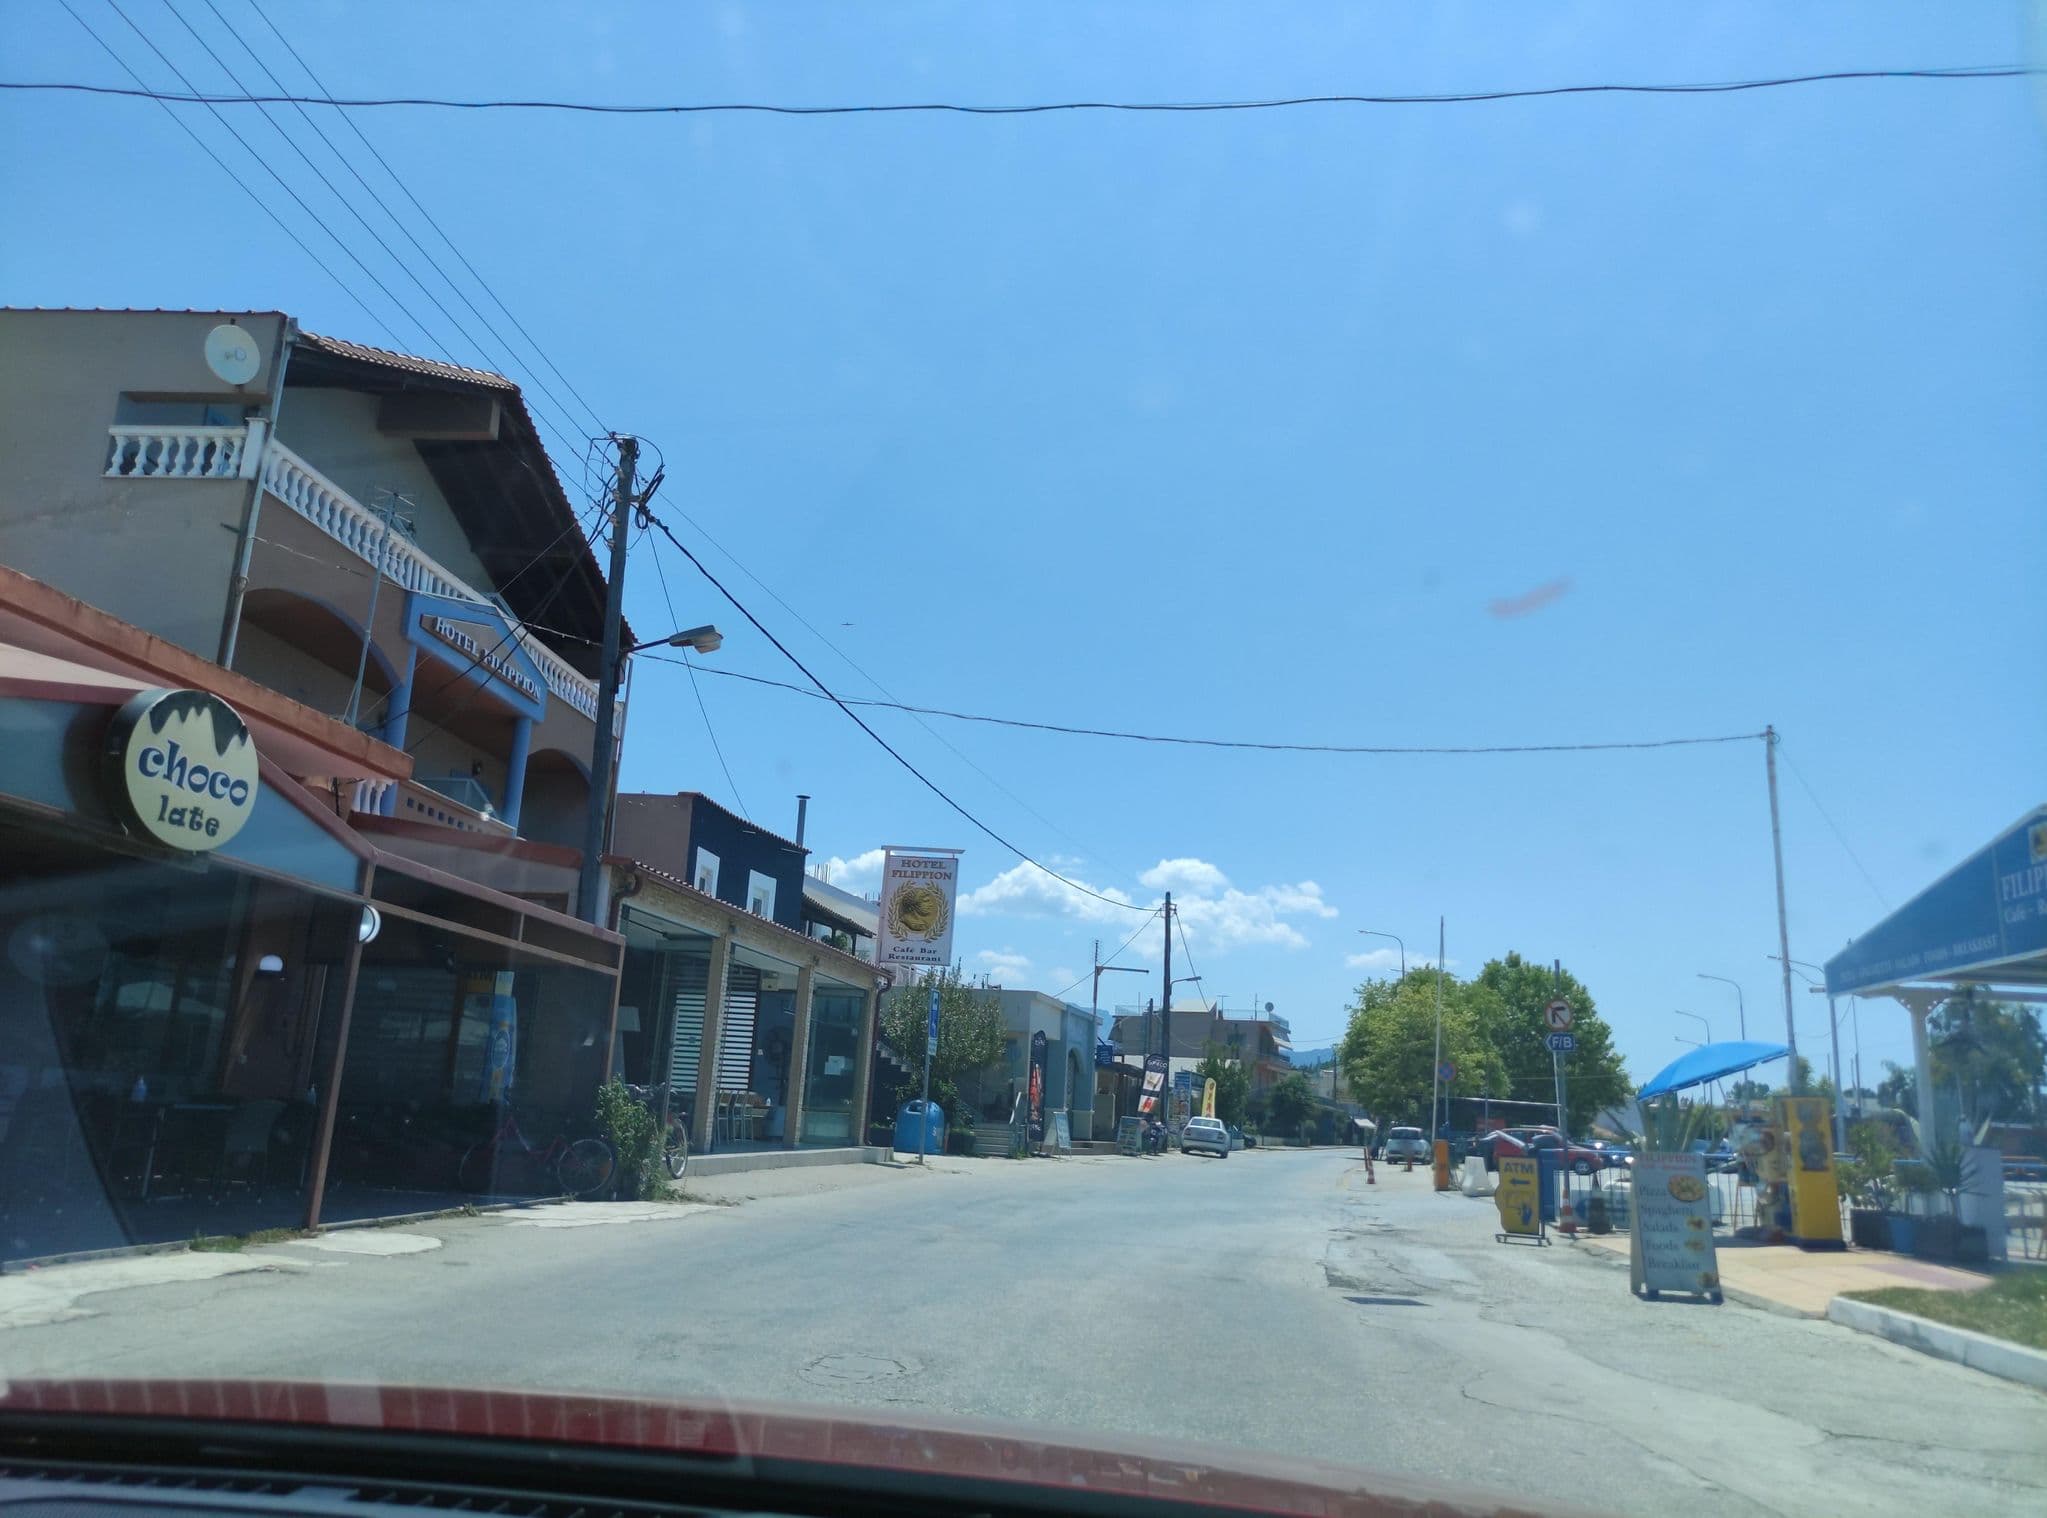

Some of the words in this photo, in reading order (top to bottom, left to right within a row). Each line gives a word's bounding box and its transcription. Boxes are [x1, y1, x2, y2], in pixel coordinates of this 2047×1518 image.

[435, 616, 480, 658] HOTEL
[138, 739, 249, 807] choco
[157, 794, 220, 838] late
[901, 859, 946, 870] HOTEL
[891, 870, 953, 880] FILIPPION
[888, 953, 941, 962] Restaurant
[920, 947, 938, 956] Bar
[1503, 1161, 1534, 1175] ATM
